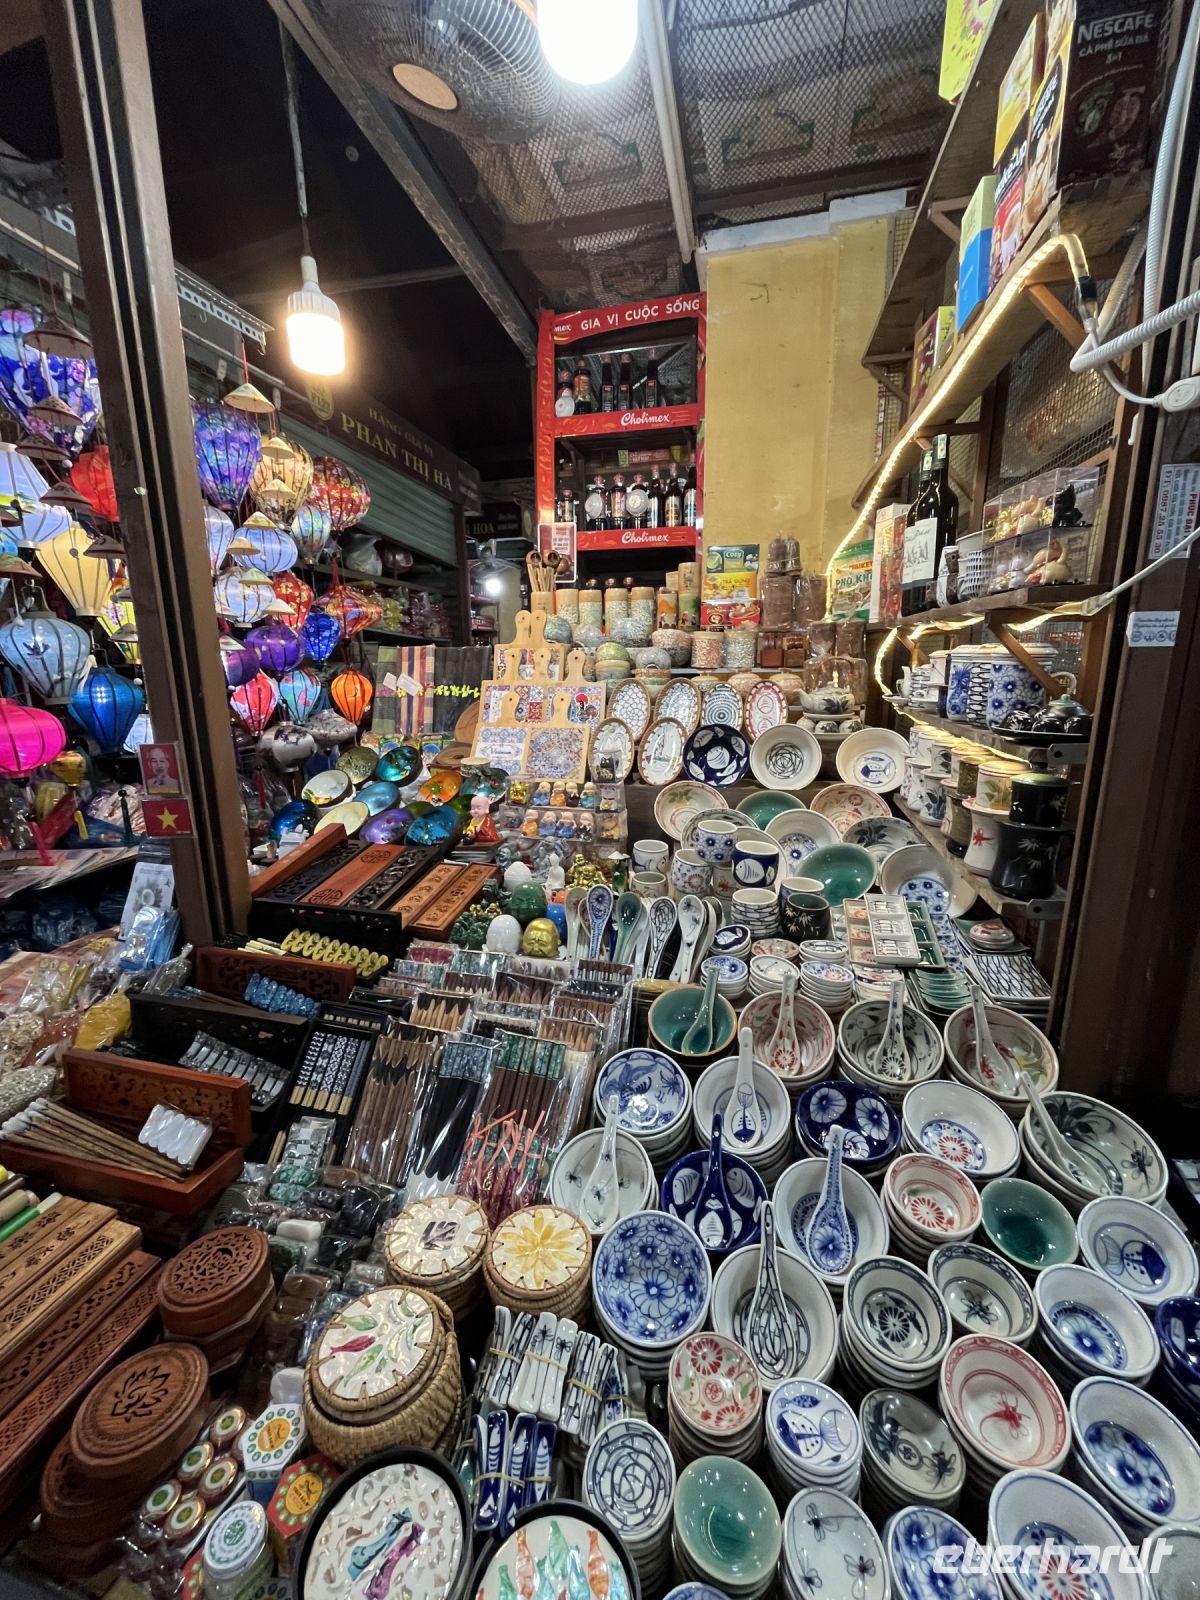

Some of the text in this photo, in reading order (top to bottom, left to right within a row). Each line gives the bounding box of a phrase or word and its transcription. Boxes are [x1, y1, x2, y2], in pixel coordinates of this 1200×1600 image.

[580, 297, 700, 331] GIA VỊ CUỘC SỐNG
[621, 411, 670, 426] Cholimex
[341, 412, 397, 459] PHAN
[621, 530, 670, 544] Cholimex
